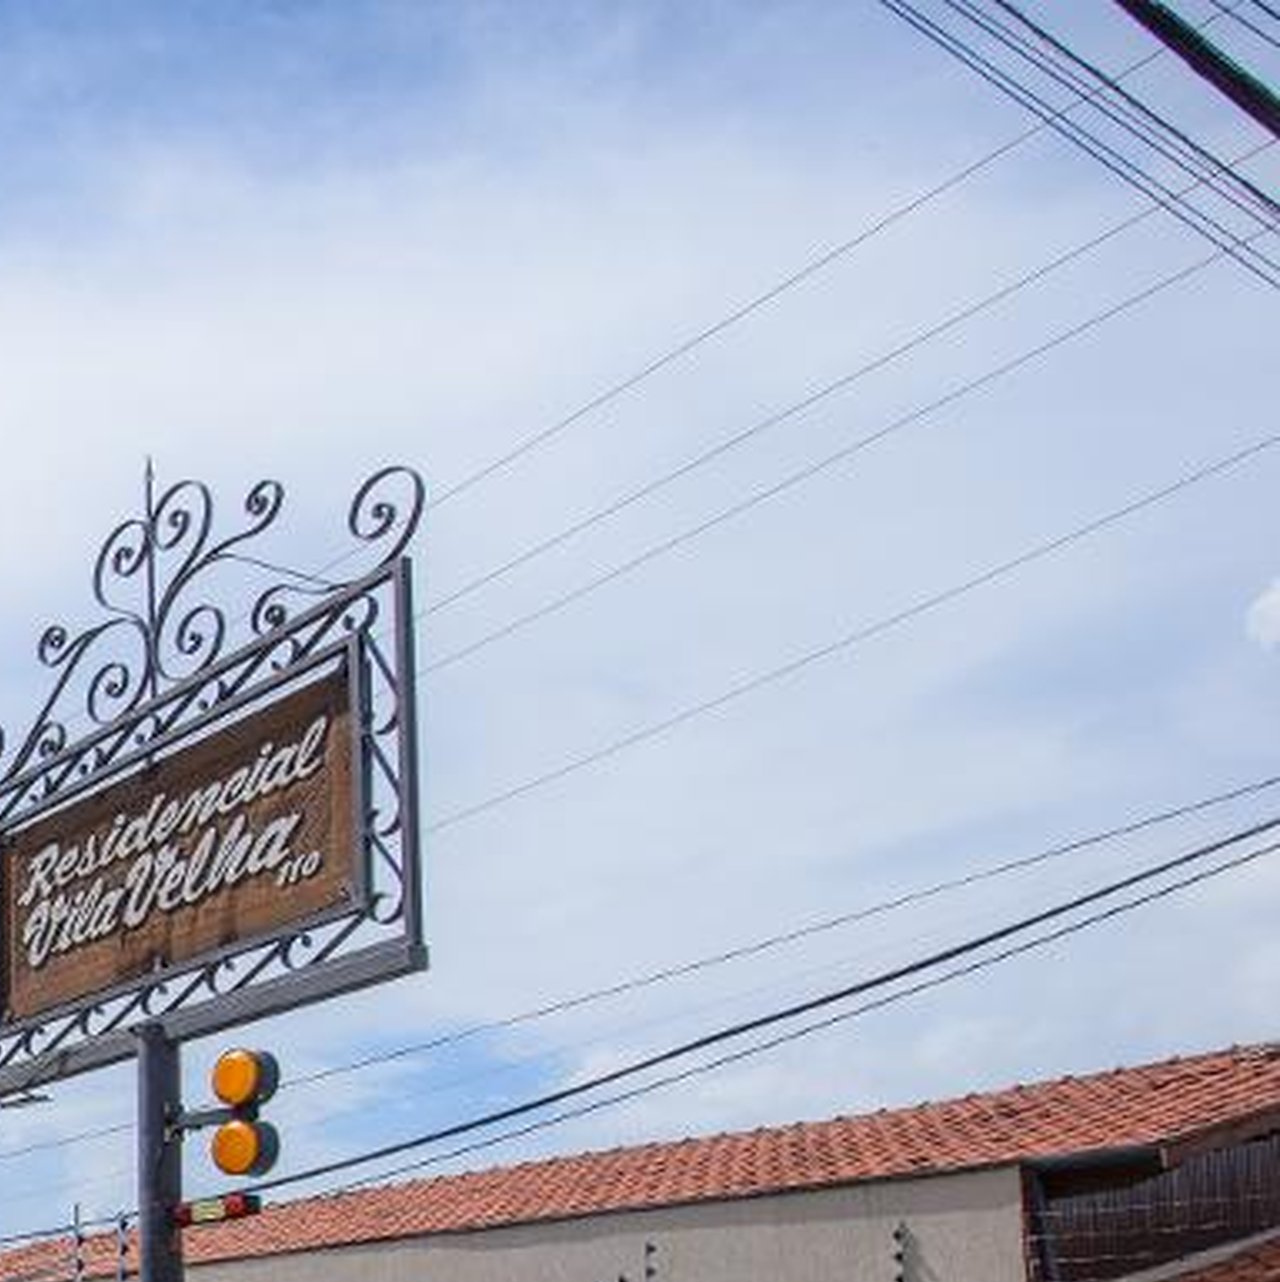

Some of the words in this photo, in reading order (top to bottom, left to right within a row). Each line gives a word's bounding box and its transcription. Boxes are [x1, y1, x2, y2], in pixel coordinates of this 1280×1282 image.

[18, 715, 328, 906] Residencial
[23, 877, 126, 966] Vila
[121, 811, 301, 926] Velha
